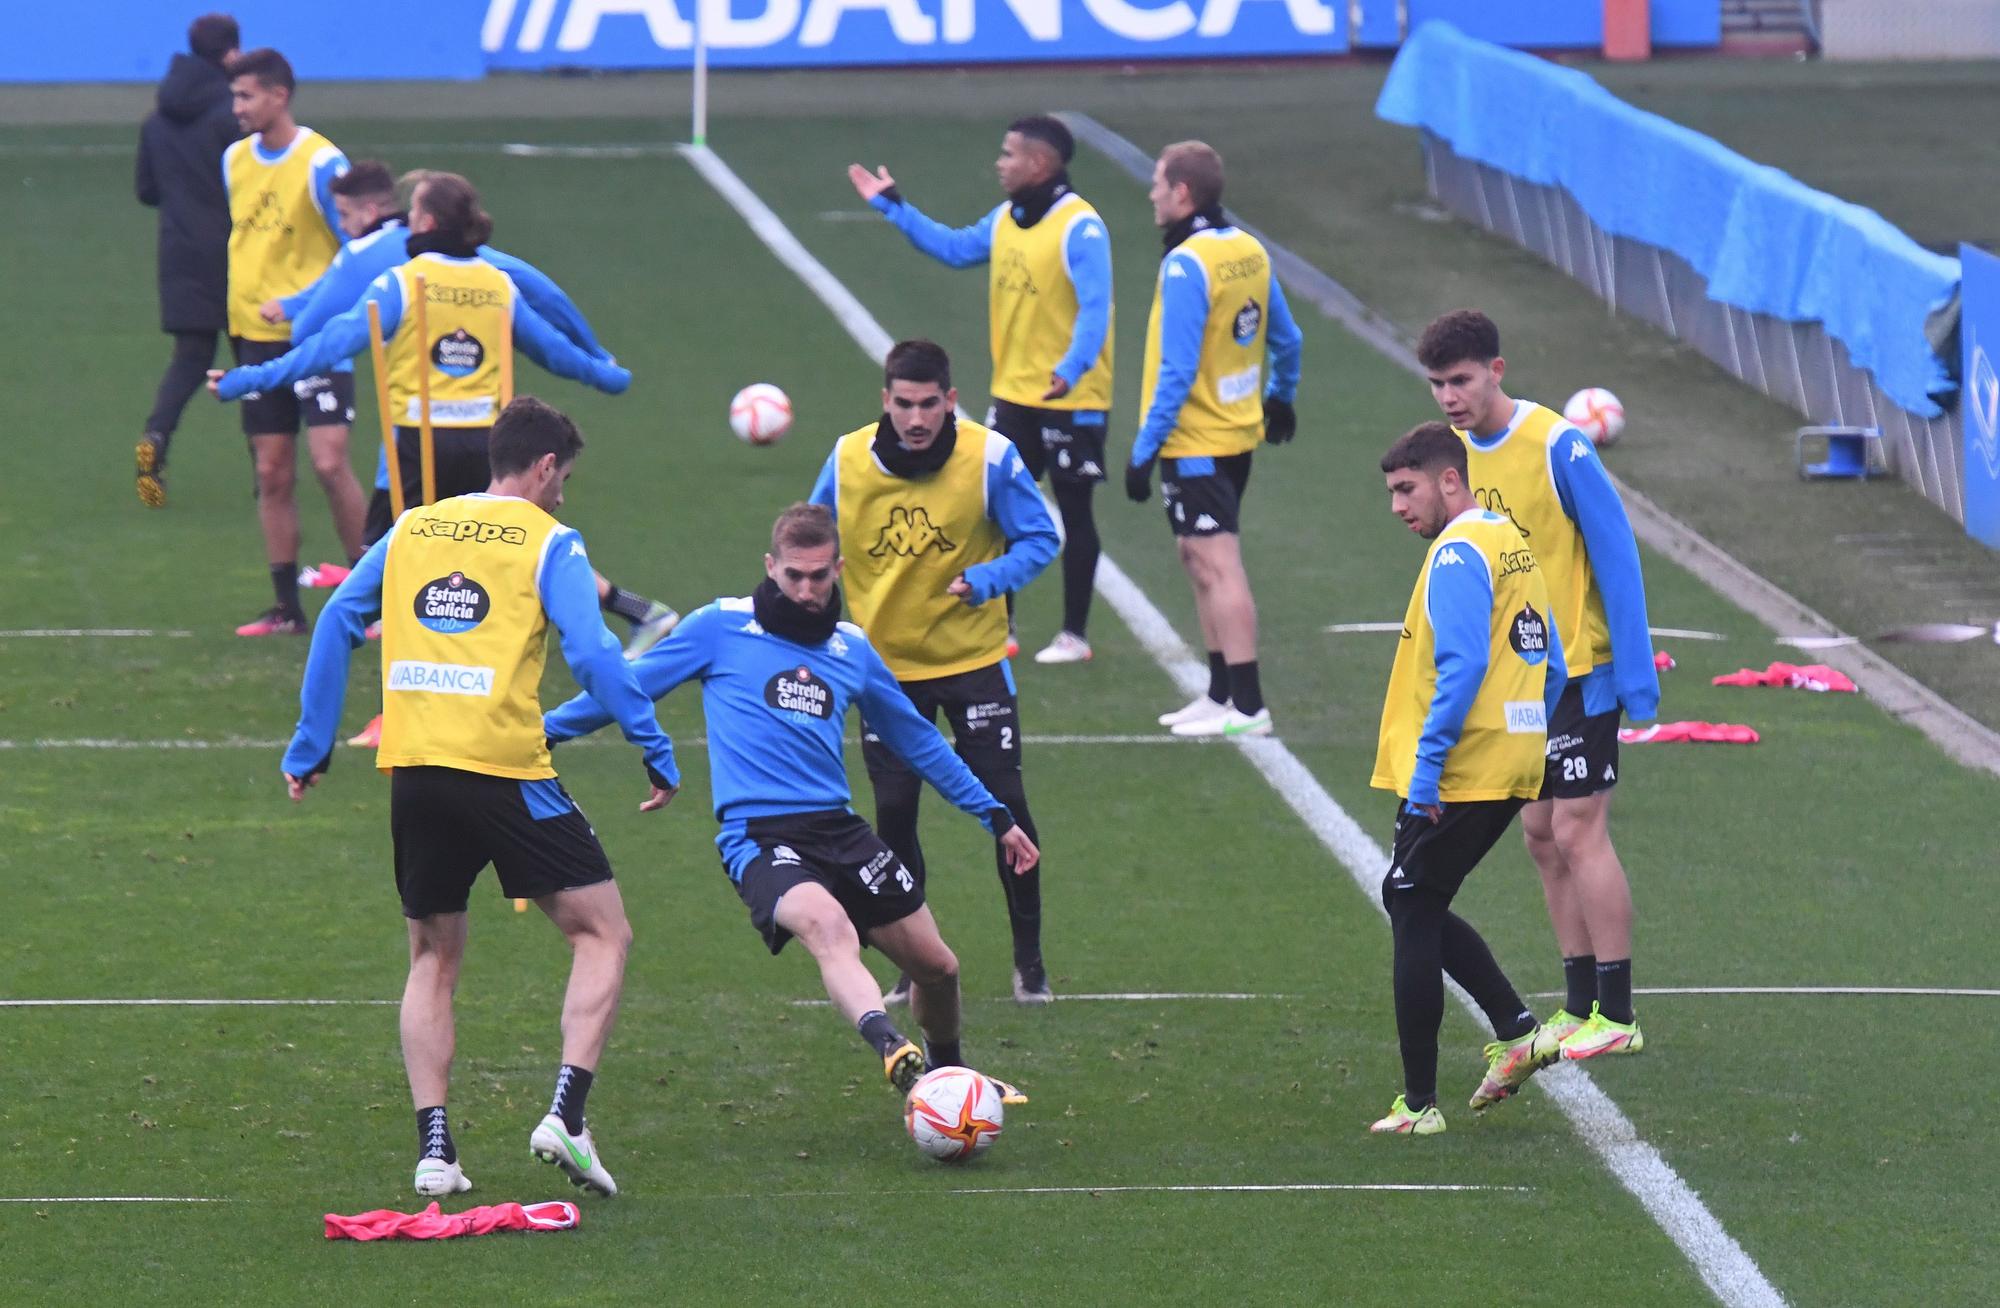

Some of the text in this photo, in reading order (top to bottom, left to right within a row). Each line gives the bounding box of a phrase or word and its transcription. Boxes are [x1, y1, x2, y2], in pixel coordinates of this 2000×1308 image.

[411, 518, 527, 545] Kappa
[425, 586, 480, 605] Estrella
[425, 601, 475, 620] Galicia
[776, 677, 827, 702] Estrella
[778, 692, 823, 716] Galicia
[1001, 726, 1013, 750] 2
[1563, 756, 1588, 781] 28
